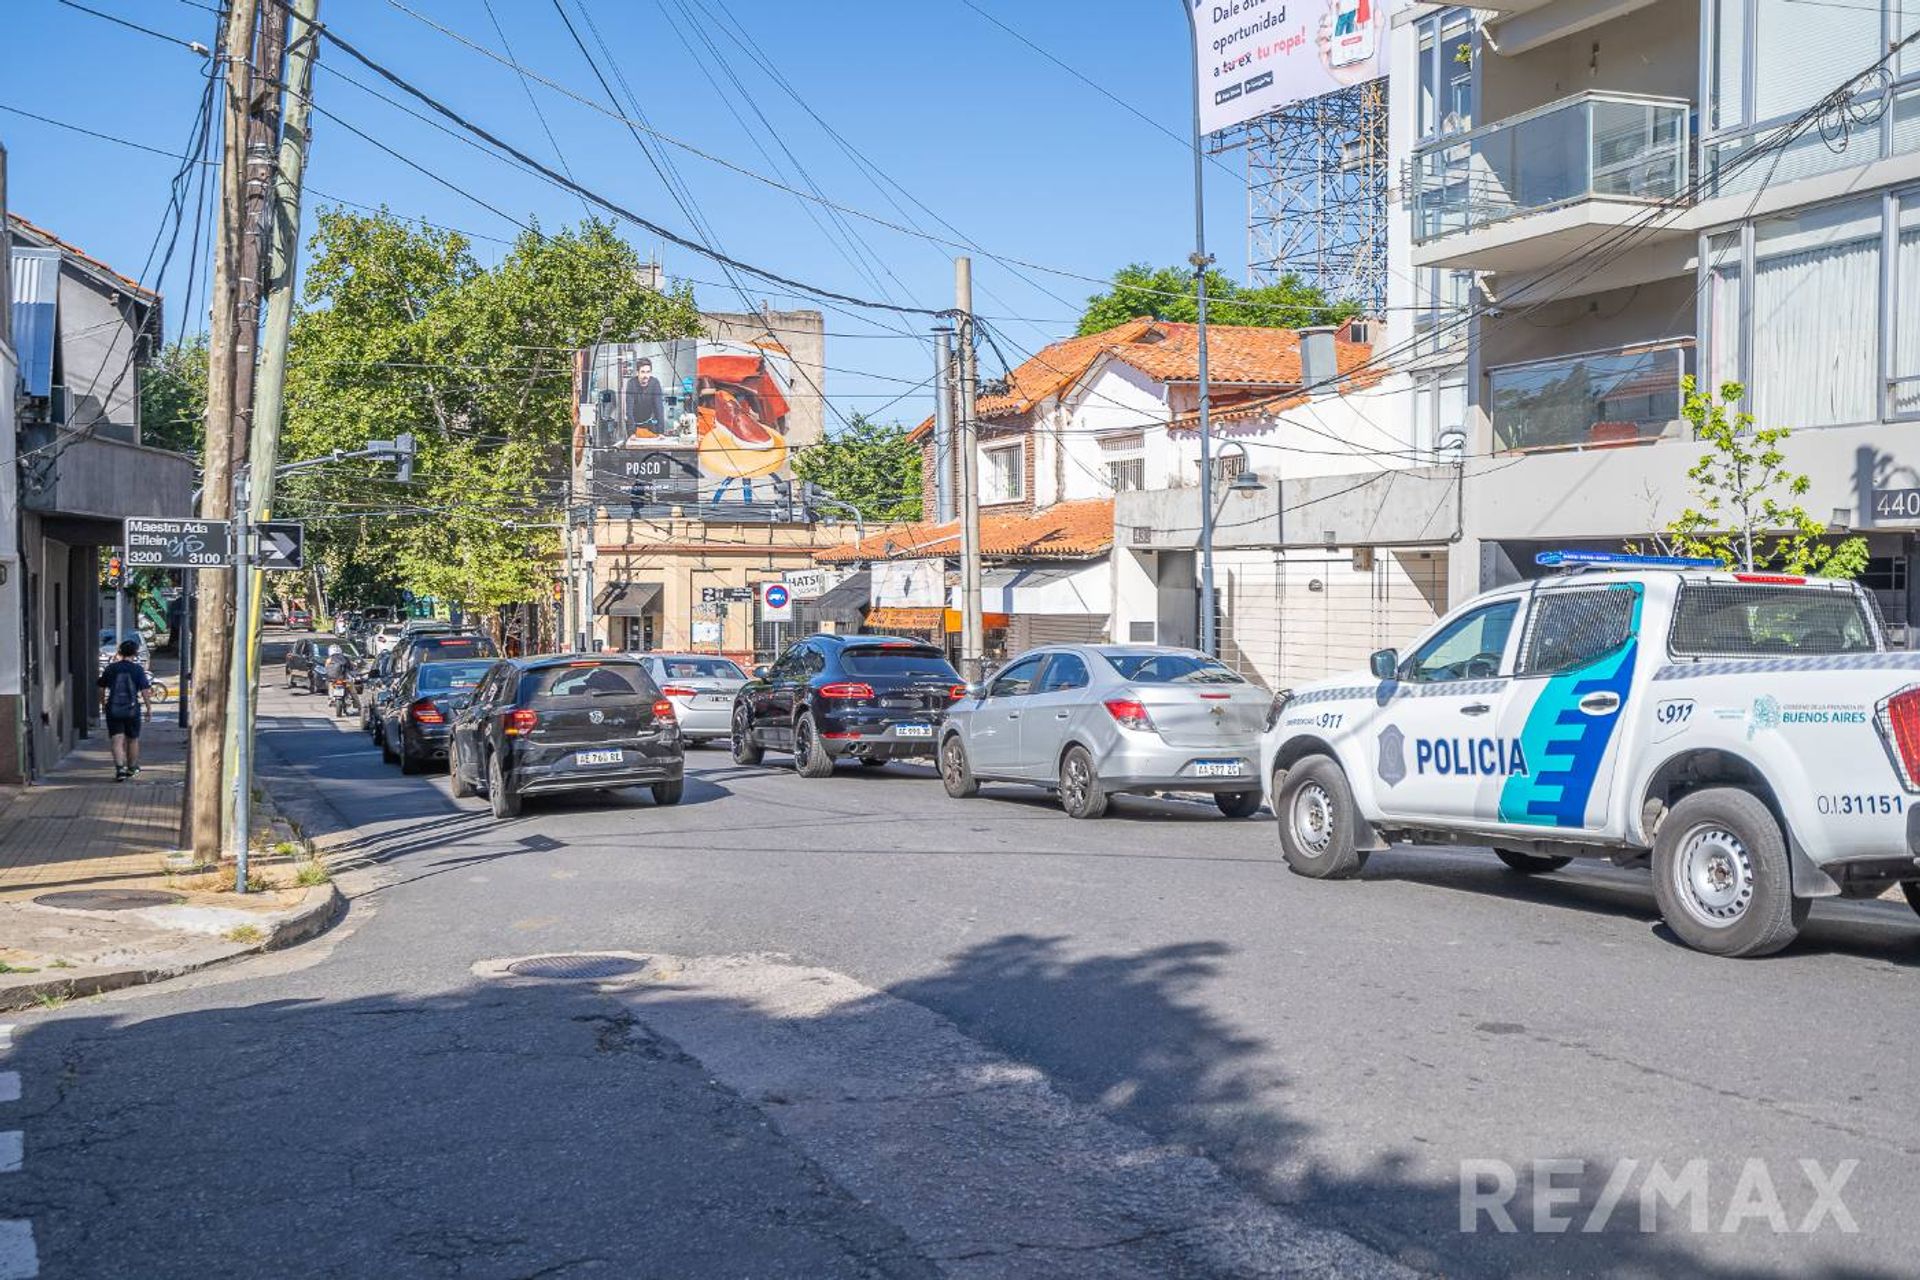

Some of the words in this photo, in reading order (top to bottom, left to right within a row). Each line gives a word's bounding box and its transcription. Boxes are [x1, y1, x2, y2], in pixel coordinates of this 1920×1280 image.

[1213, 0, 1240, 24] Dale
[1213, 5, 1286, 55] oportunidad
[1213, 66, 1220, 77] a
[1238, 52, 1252, 67] ex
[1257, 46, 1270, 60] tu
[1274, 25, 1306, 56] ropa!
[626, 462, 660, 475] POSCO
[1877, 491, 1920, 516] 440
[130, 521, 180, 533] Maestra
[182, 523, 208, 534] Ada
[130, 534, 167, 545] Elflein
[130, 551, 162, 562] 3200
[188, 553, 220, 564] 3100
[1321, 713, 1344, 729] 911
[1666, 704, 1694, 725] 911
[1783, 712, 1829, 723] BUENOS
[1831, 712, 1866, 723] AIRES
[1416, 738, 1528, 775] POLICIA
